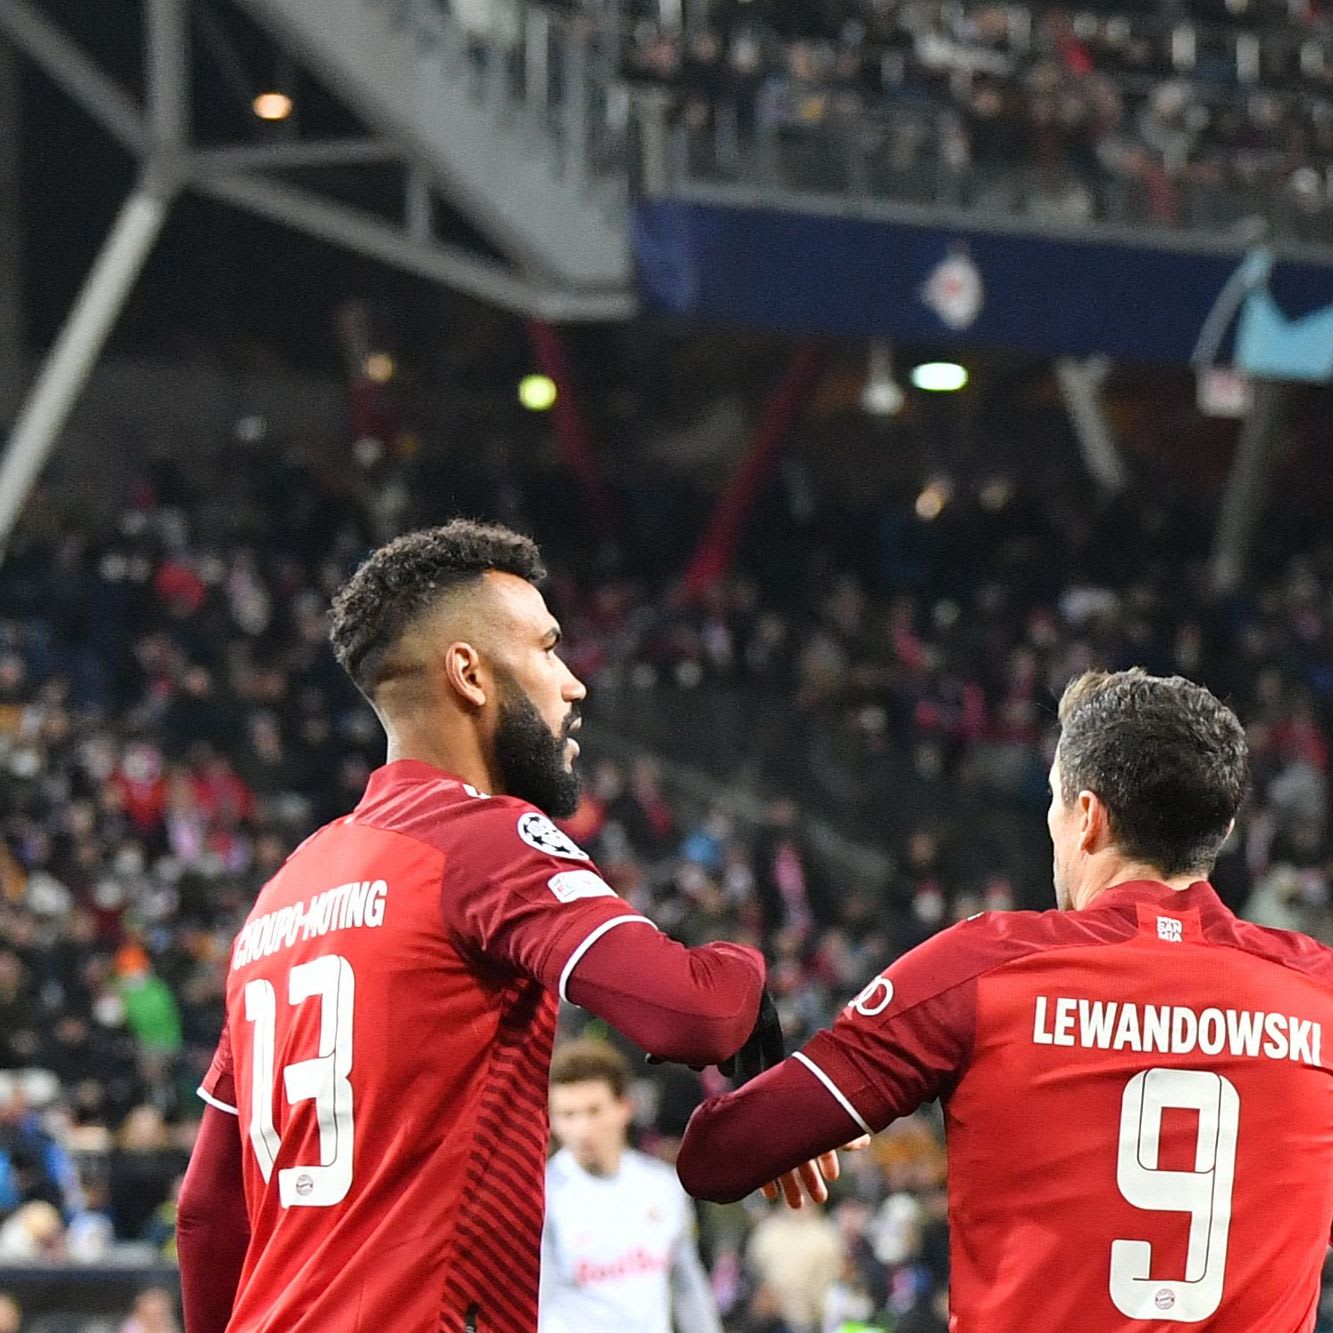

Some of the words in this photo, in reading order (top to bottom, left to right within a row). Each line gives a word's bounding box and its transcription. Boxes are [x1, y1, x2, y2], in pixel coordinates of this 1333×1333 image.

[245, 954, 355, 1208] 13
[1033, 997, 1321, 1067] LEWANDOWSKI
[1109, 1067, 1240, 1322] 9
